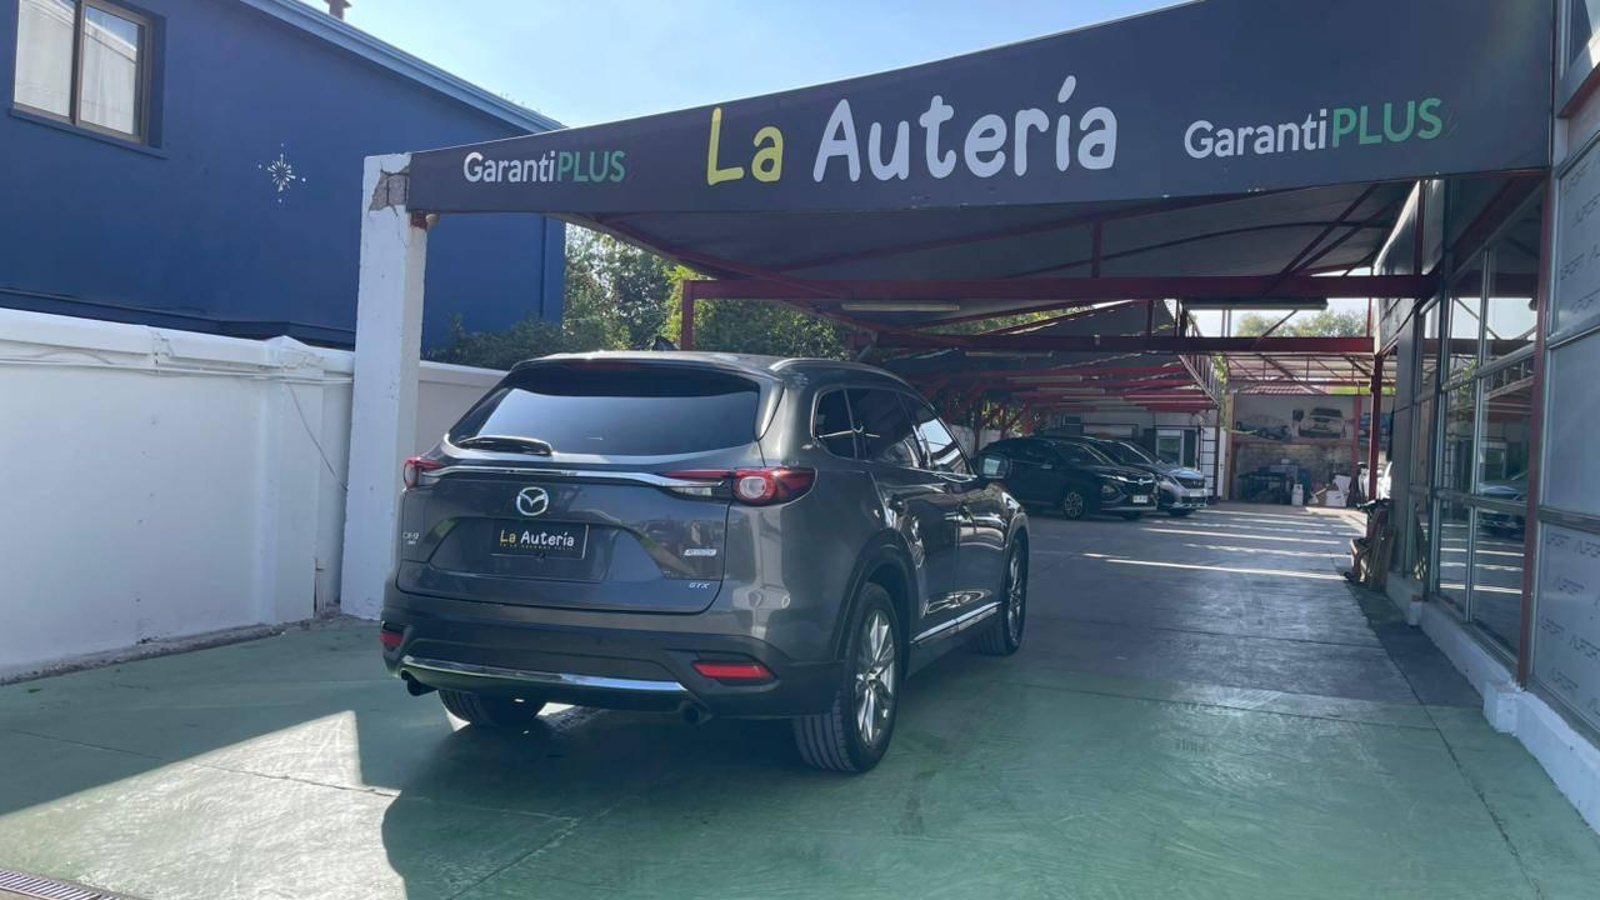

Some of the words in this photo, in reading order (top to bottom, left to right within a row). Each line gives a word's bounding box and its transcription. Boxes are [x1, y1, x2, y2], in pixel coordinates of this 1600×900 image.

[707, 107, 785, 186] La
[813, 75, 1118, 182] Autería
[1184, 97, 1443, 159] GarantiPLUS
[463, 150, 627, 183] GarantiPLUS
[500, 529, 517, 544] La
[520, 530, 575, 547] Autería
